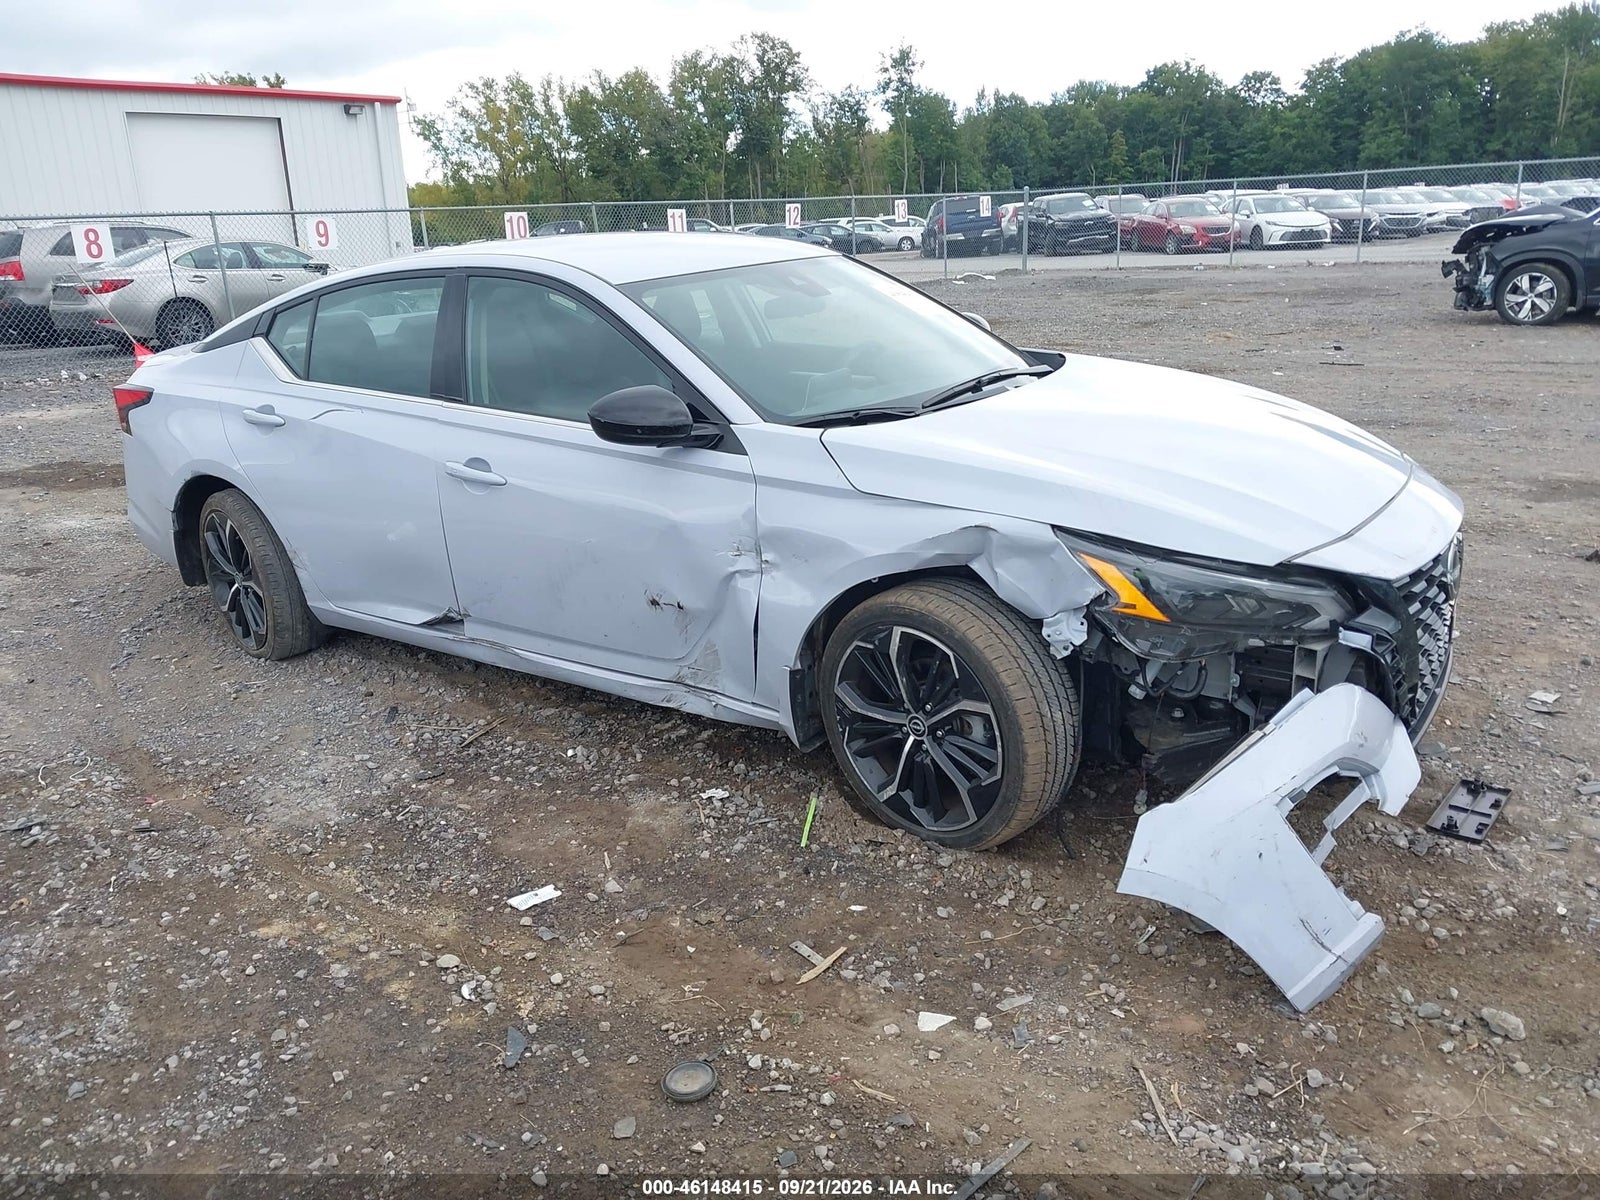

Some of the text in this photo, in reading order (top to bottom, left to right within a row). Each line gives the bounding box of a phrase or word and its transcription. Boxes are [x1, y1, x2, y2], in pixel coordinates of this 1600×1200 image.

[786, 206, 800, 226] 12
[896, 202, 907, 220] 13
[981, 197, 990, 216] 14
[507, 215, 527, 239] 10
[670, 212, 684, 232] 11
[83, 228, 103, 259] 8
[316, 220, 329, 247] 9
